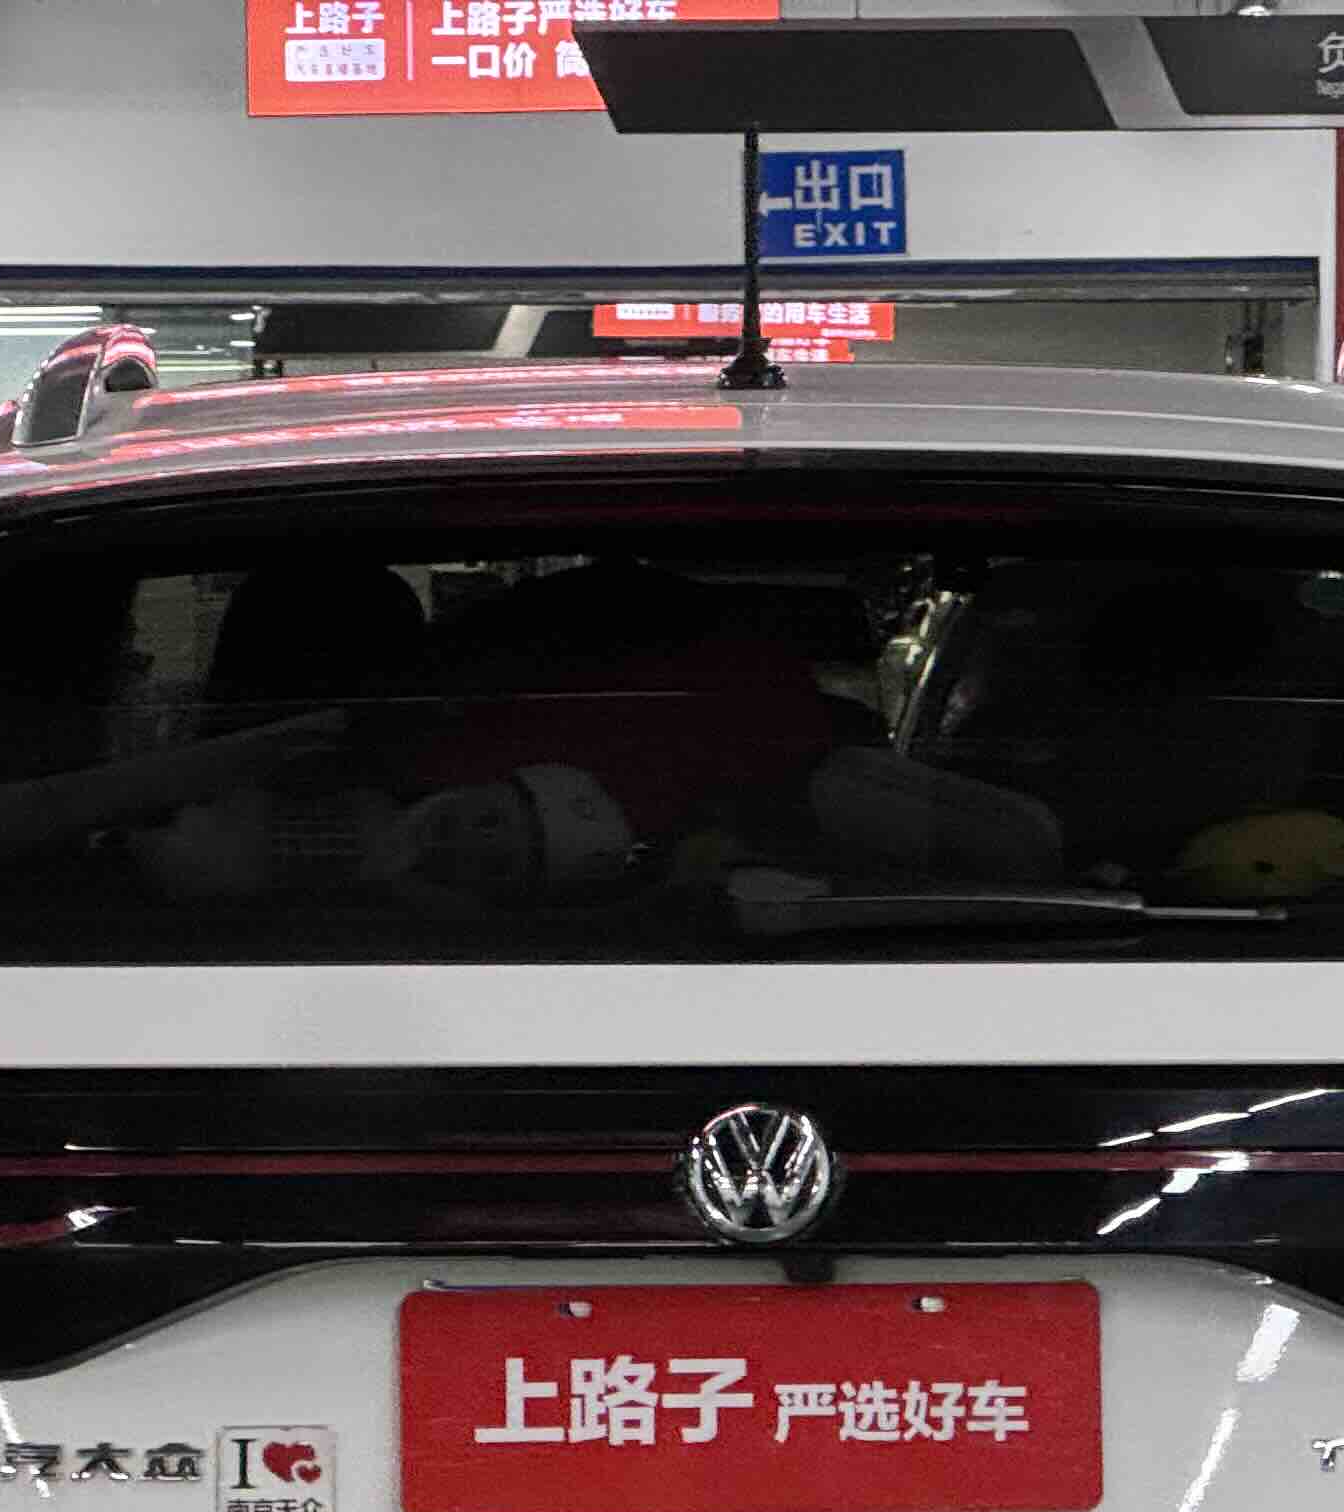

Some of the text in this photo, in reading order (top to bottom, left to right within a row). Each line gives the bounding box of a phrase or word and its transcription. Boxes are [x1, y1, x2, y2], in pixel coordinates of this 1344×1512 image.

[286, 2, 385, 34] 上路子
[431, 42, 537, 80] 一口价
[794, 159, 895, 211] 出口
[793, 221, 898, 248] EXIT
[474, 1354, 1029, 1446] 上路子 严选好车
